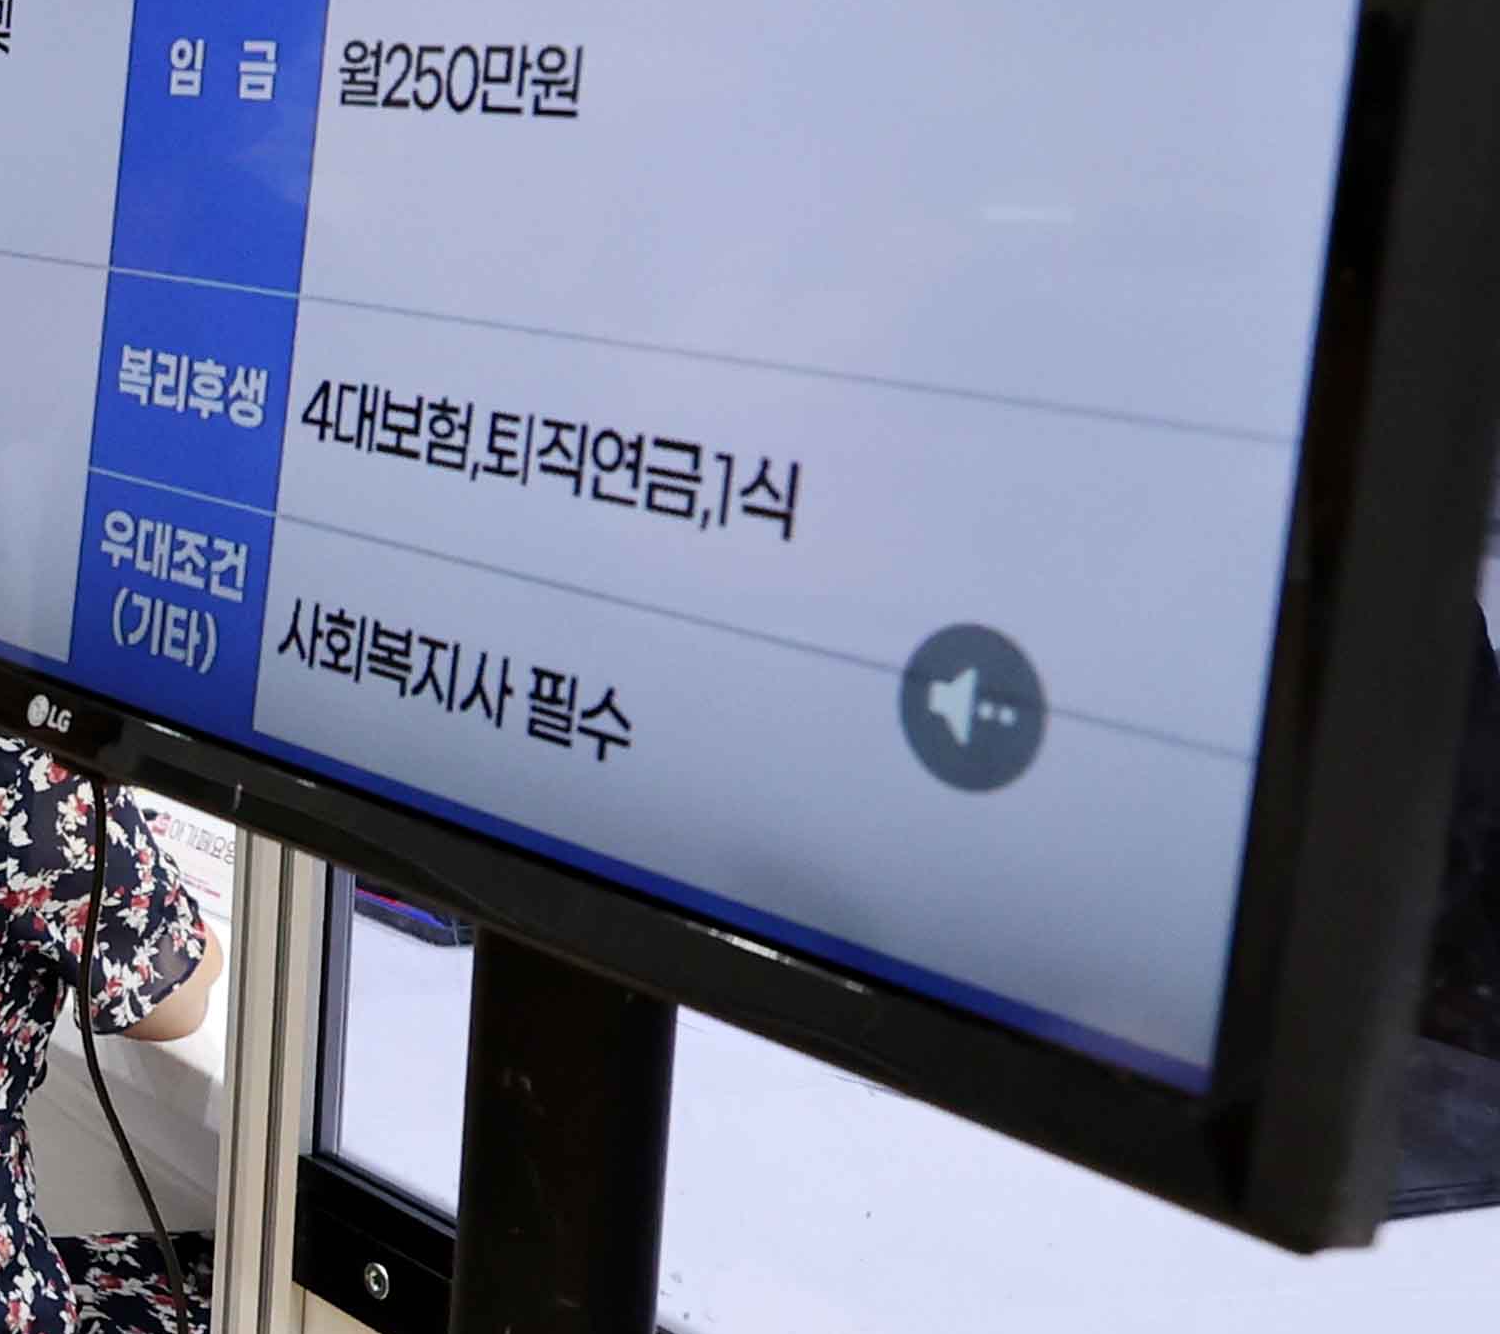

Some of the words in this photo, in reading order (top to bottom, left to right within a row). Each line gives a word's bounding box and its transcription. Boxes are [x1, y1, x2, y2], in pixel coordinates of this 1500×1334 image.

[338, 39, 583, 118] 월250만원
[116, 344, 269, 430] 복리후생
[301, 379, 802, 540] 4대보험,퇴직연금,1식
[99, 510, 249, 604] 우대조건
[112, 587, 219, 675] (기타)
[46, 703, 73, 734] LG
[277, 597, 514, 729] 사회복지사
[526, 666, 632, 762] 필수
